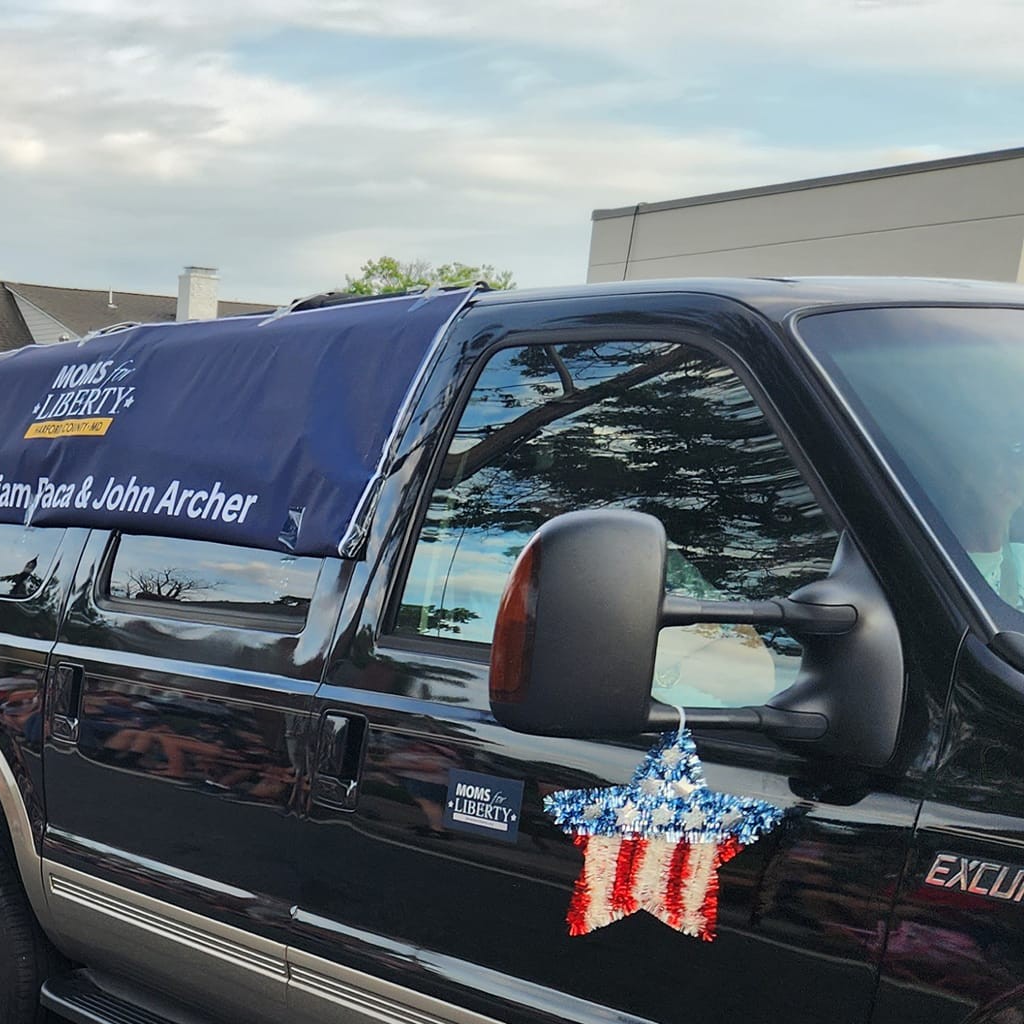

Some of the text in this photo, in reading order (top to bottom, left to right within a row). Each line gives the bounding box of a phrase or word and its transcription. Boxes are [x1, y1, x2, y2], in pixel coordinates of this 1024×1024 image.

[51, 359, 136, 389] MOMS for
[35, 386, 136, 420] LIBERTY
[75, 475, 94, 509] &
[93, 476, 155, 513] John
[154, 480, 258, 523] Archer
[455, 782, 507, 806] MOMS for
[454, 797, 512, 822] LIBERTY
